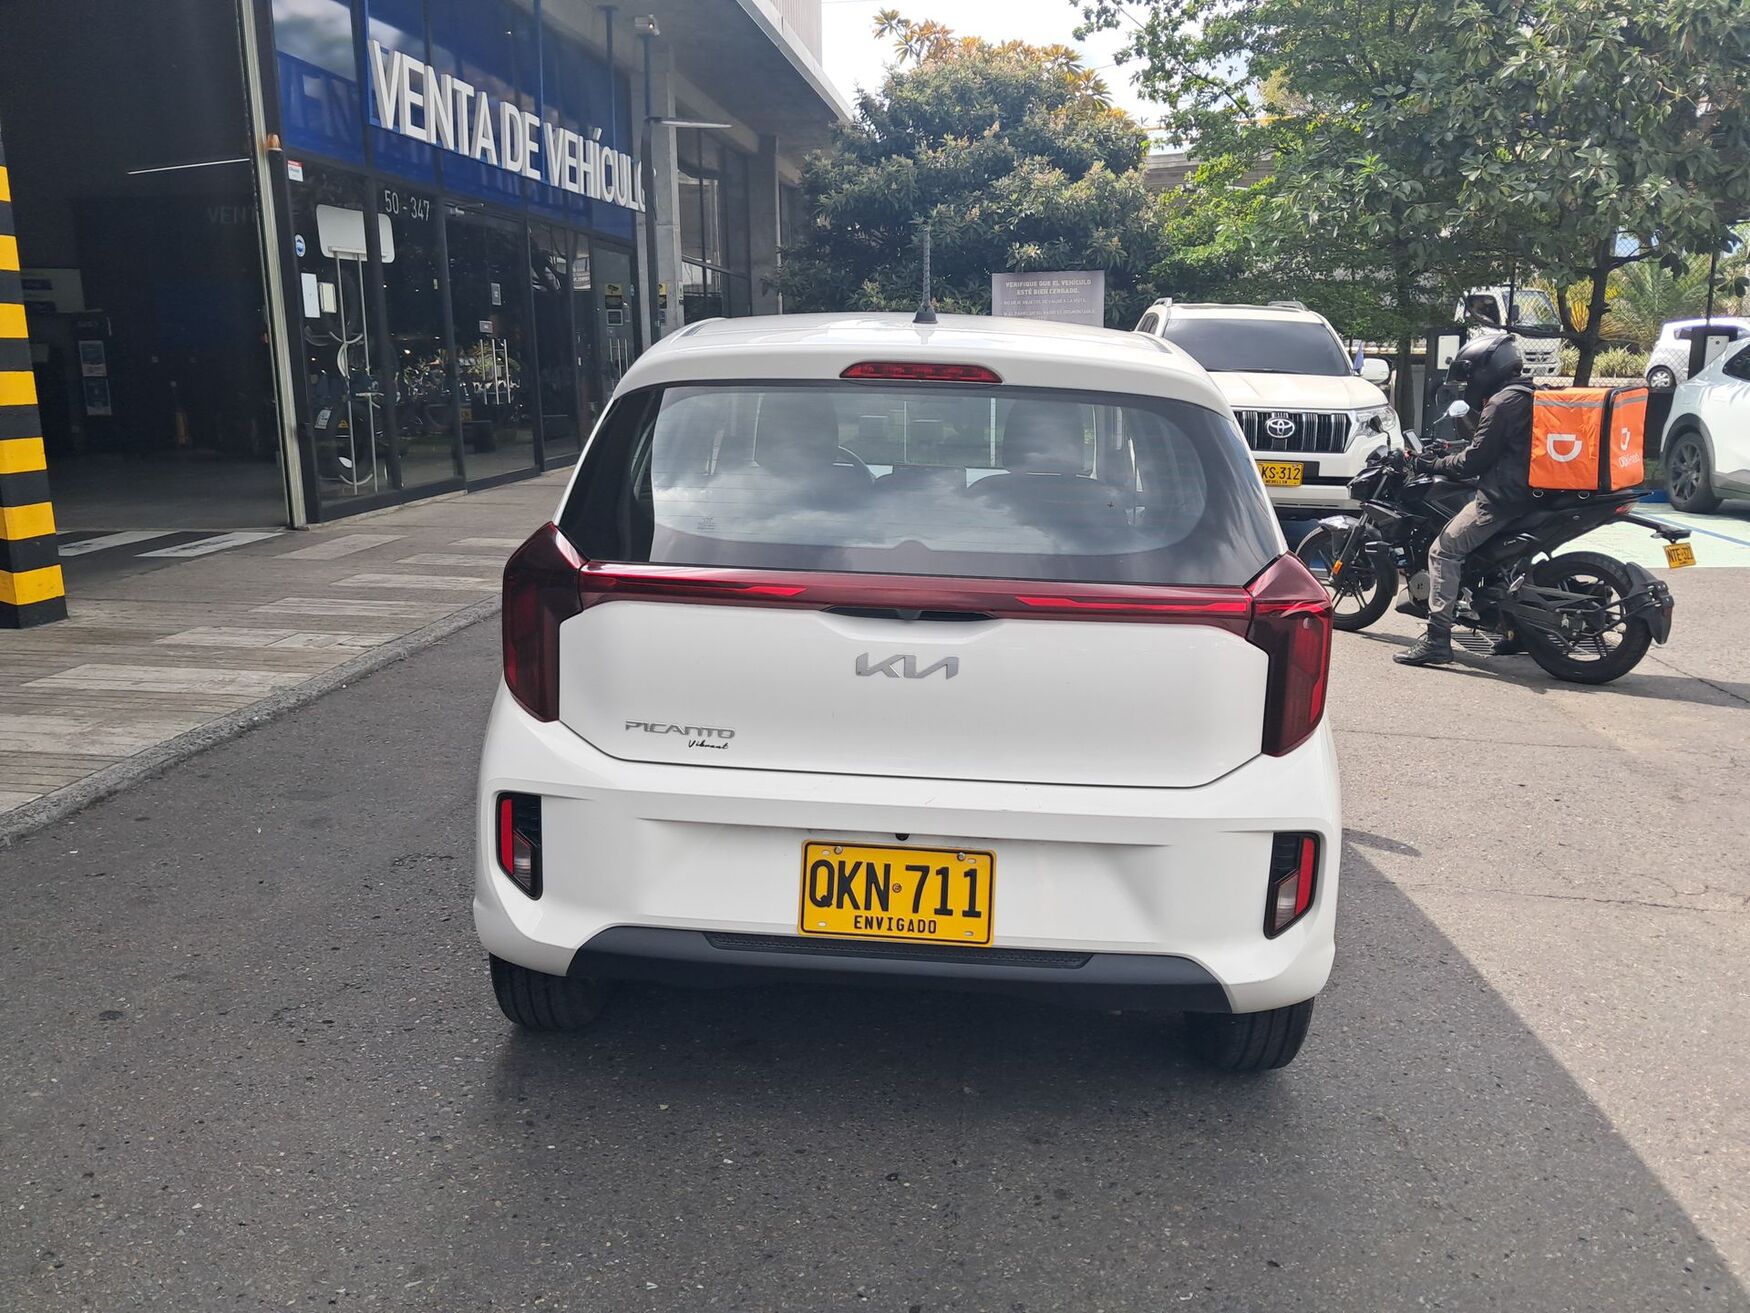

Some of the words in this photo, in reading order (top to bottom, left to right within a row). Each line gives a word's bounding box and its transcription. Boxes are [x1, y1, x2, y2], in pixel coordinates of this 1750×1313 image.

[368, 39, 498, 166] VENTA
[500, 100, 542, 181] DE
[384, 189, 399, 215] 50
[410, 196, 430, 222] 347
[1260, 466, 1276, 479] KS
[1279, 467, 1301, 480] 312
[624, 719, 736, 739] PICANTO
[688, 739, 729, 750] Vibrant
[808, 858, 892, 913] QKN
[905, 864, 982, 919] 711
[853, 914, 937, 934] ENVIGADO
